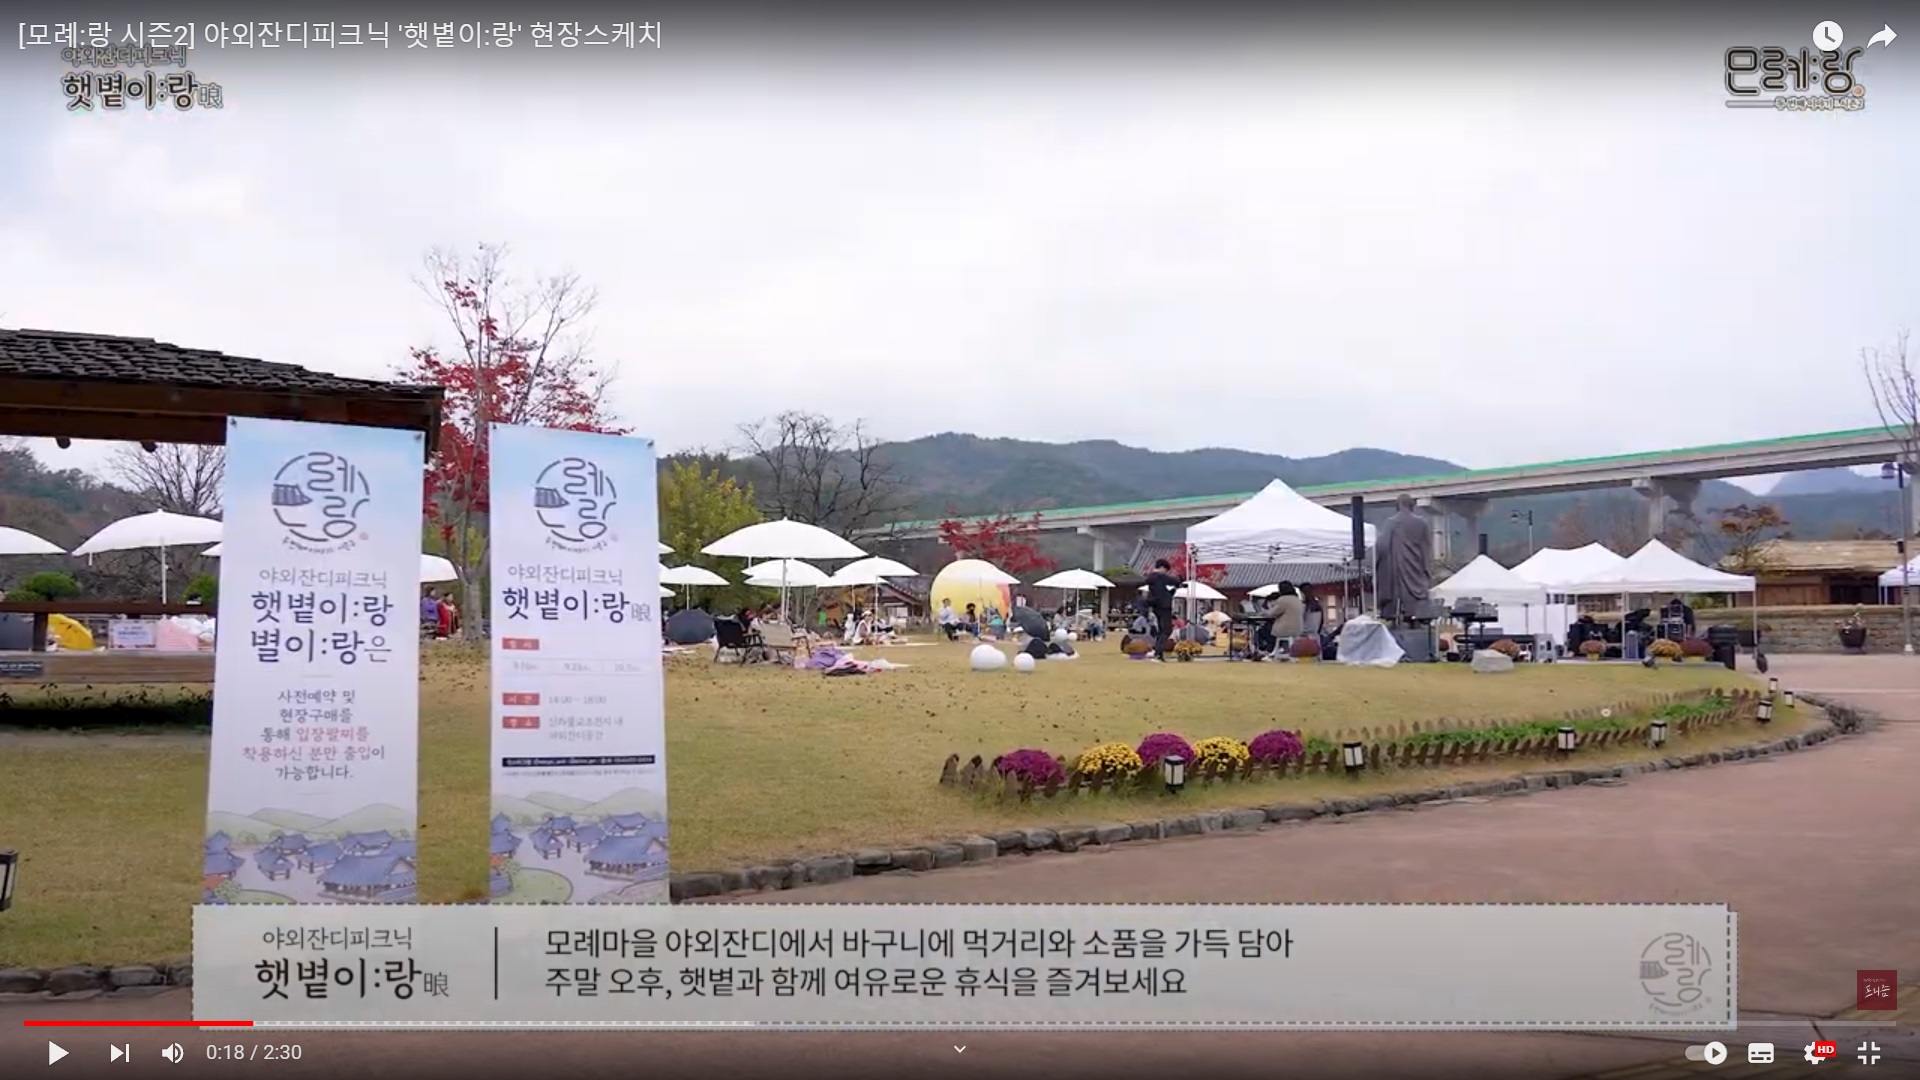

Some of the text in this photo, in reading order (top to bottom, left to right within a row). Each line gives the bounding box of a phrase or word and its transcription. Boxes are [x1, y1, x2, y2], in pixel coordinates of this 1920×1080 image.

[258, 566, 387, 590] 야외잔디피크닉
[507, 563, 623, 586] 야외잔디피크닉
[251, 590, 394, 627] 햇볕이:랑
[503, 586, 630, 624] 햇볕이:랑
[251, 628, 392, 666] 별이:랑은
[277, 689, 355, 705] 사전예약 및
[279, 707, 353, 724] 현장구매를
[260, 727, 291, 744] 통해
[242, 746, 302, 763] 착용하신
[308, 746, 337, 762] 분만
[275, 764, 354, 782] 가능합니다.
